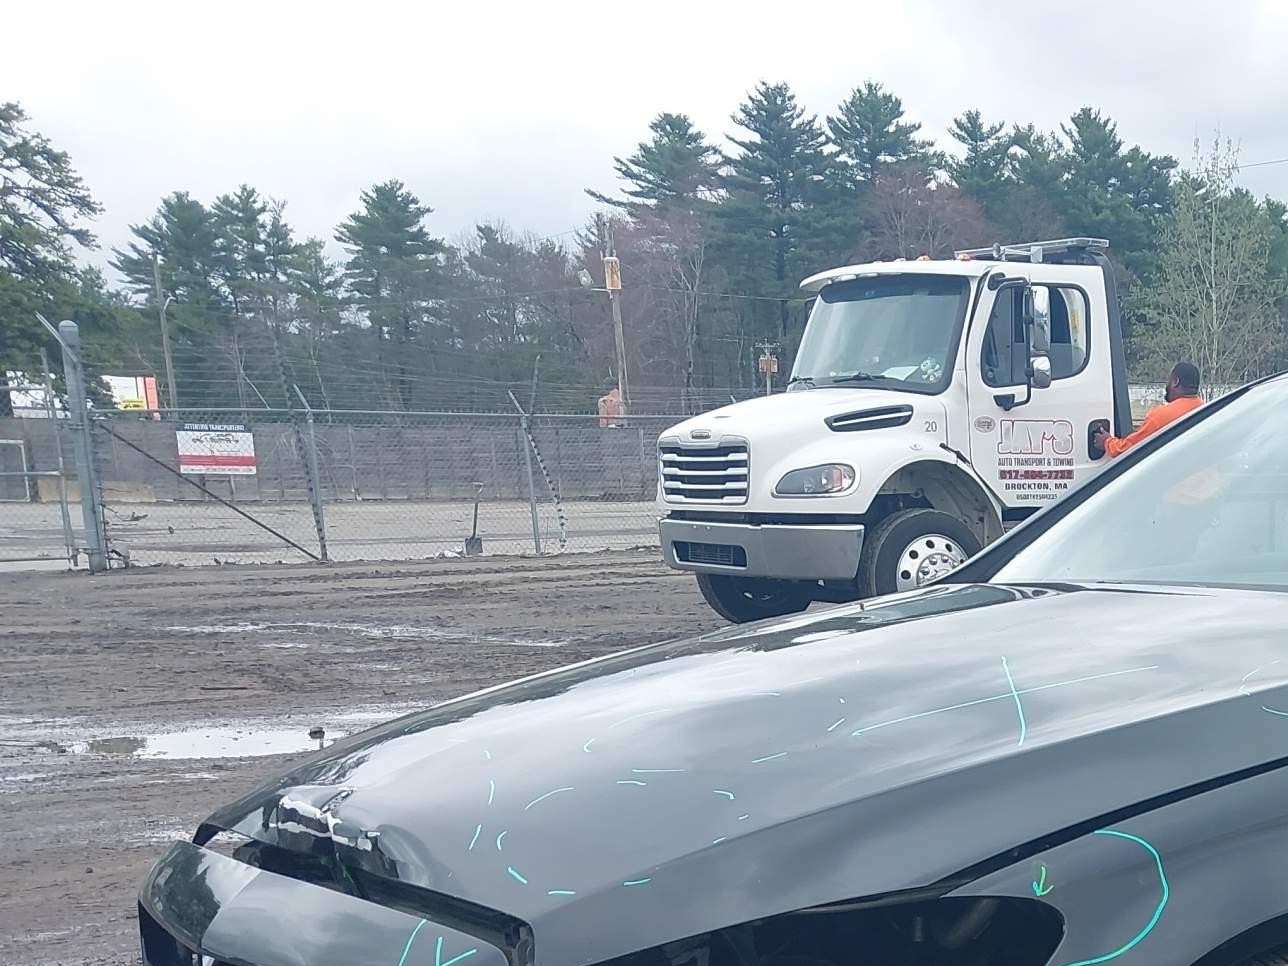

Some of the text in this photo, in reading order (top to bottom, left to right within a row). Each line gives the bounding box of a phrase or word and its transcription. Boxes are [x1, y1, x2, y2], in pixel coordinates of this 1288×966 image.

[924, 421, 938, 433] 20
[998, 458, 1074, 467] AUTO TRANSPORT & TOWING
[1005, 483, 1052, 491] BROCKTON,
